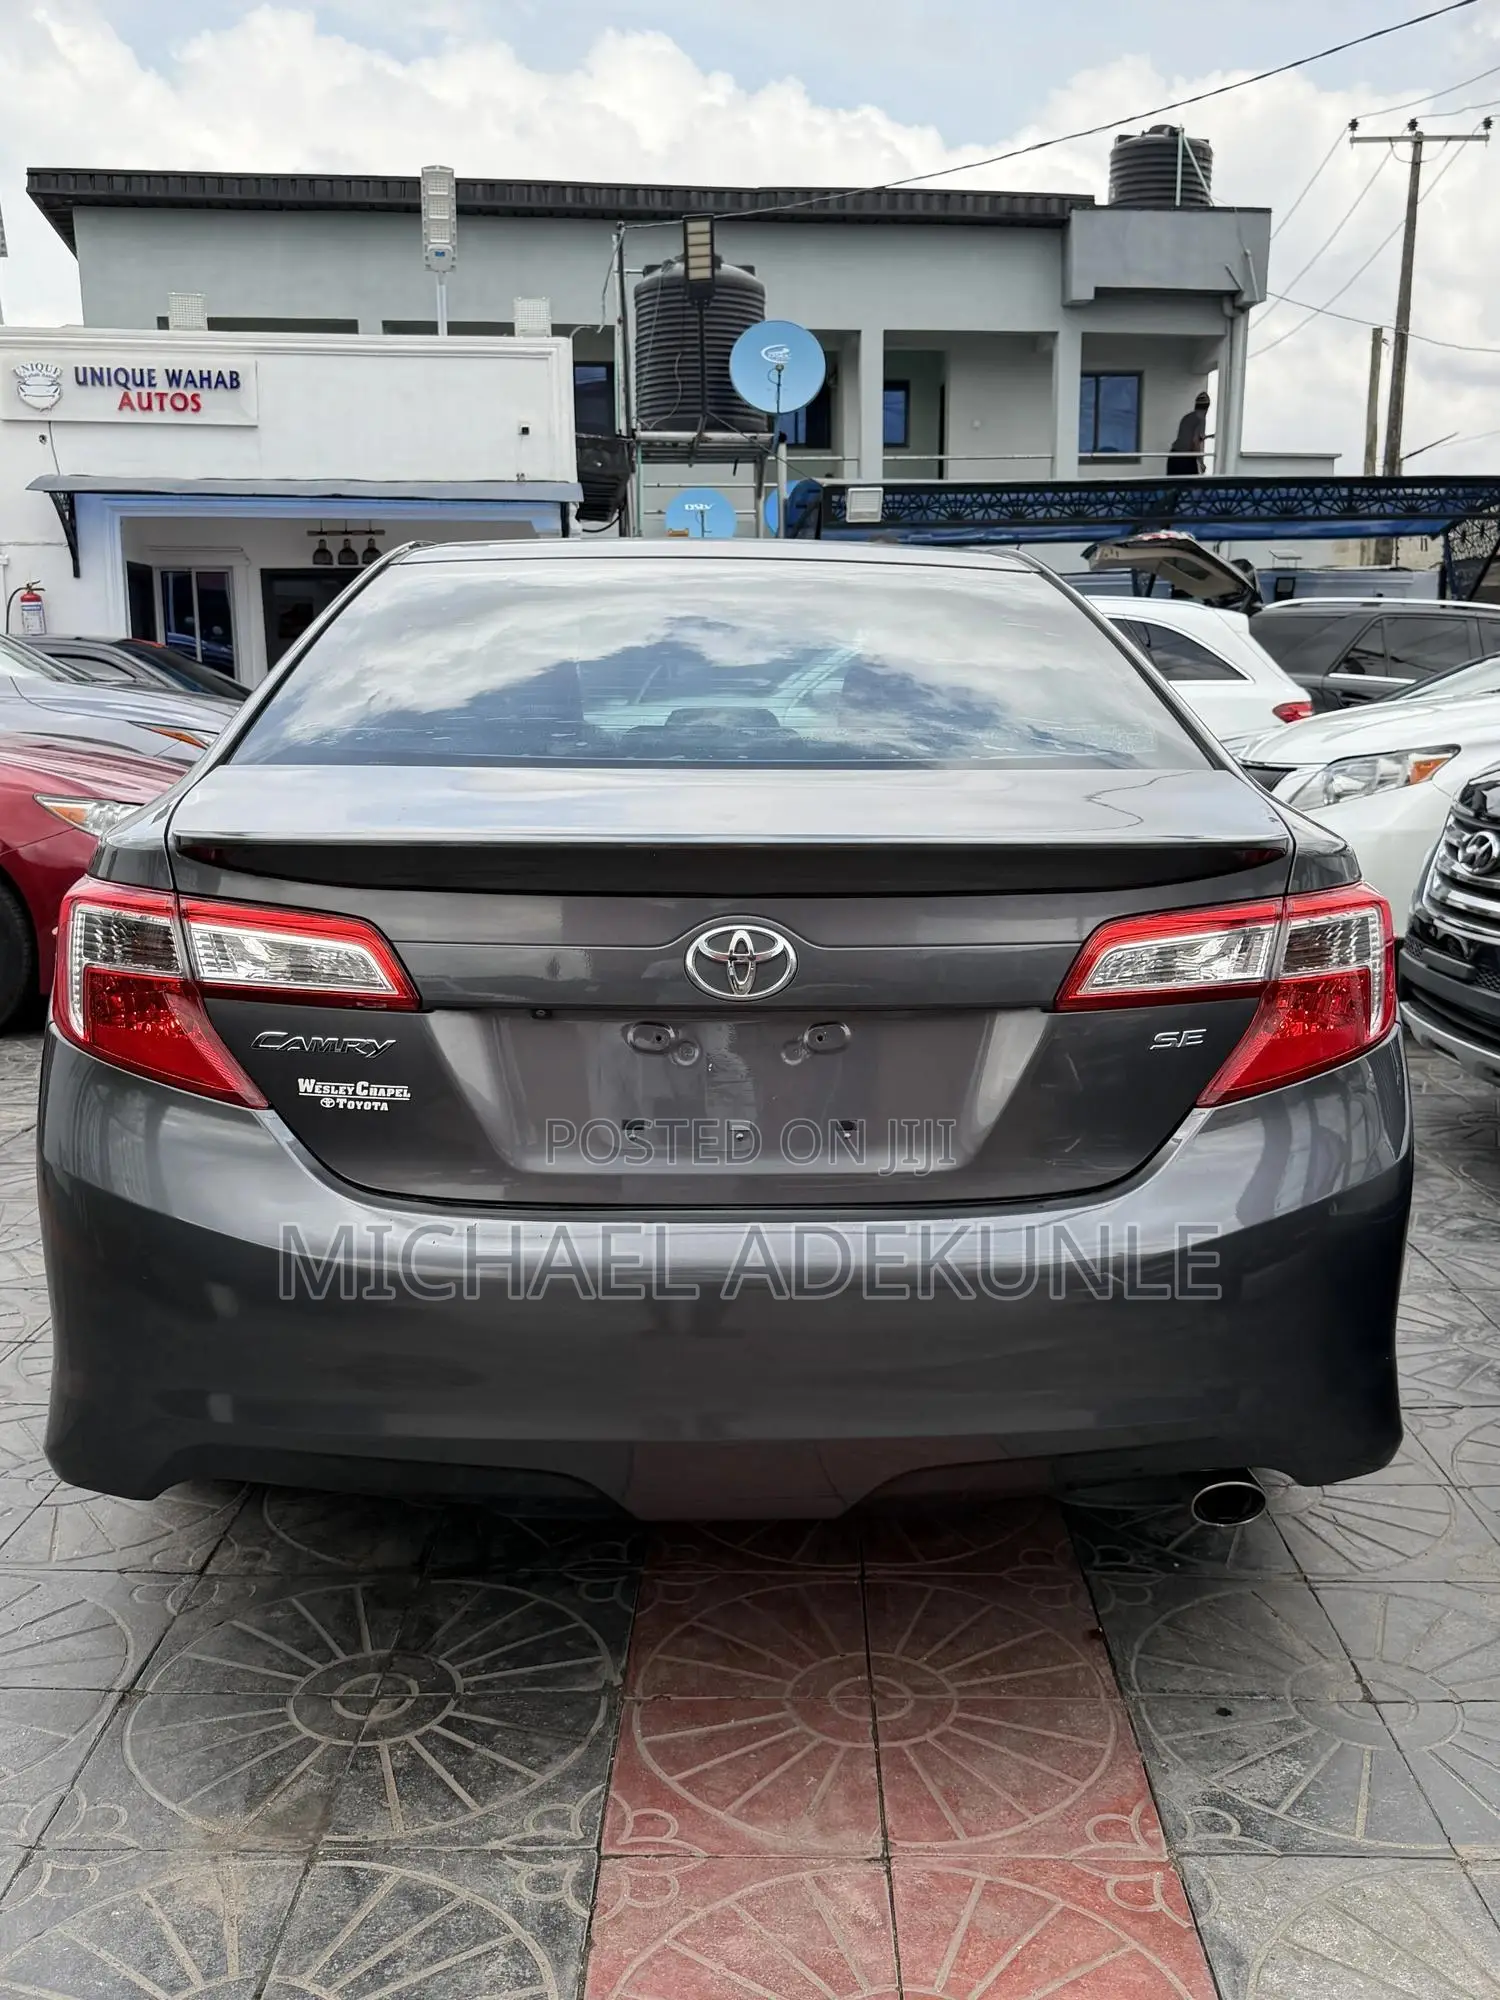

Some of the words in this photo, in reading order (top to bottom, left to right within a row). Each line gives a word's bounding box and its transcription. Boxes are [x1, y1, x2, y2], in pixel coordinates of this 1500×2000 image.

[74, 366, 157, 390] UNIQUE
[165, 368, 241, 390] WAHAB
[118, 391, 202, 412] AUTOS
[251, 1031, 396, 1058] CAMRY
[1149, 1029, 1206, 1050] SE
[336, 1098, 389, 1112] TOYOTA
